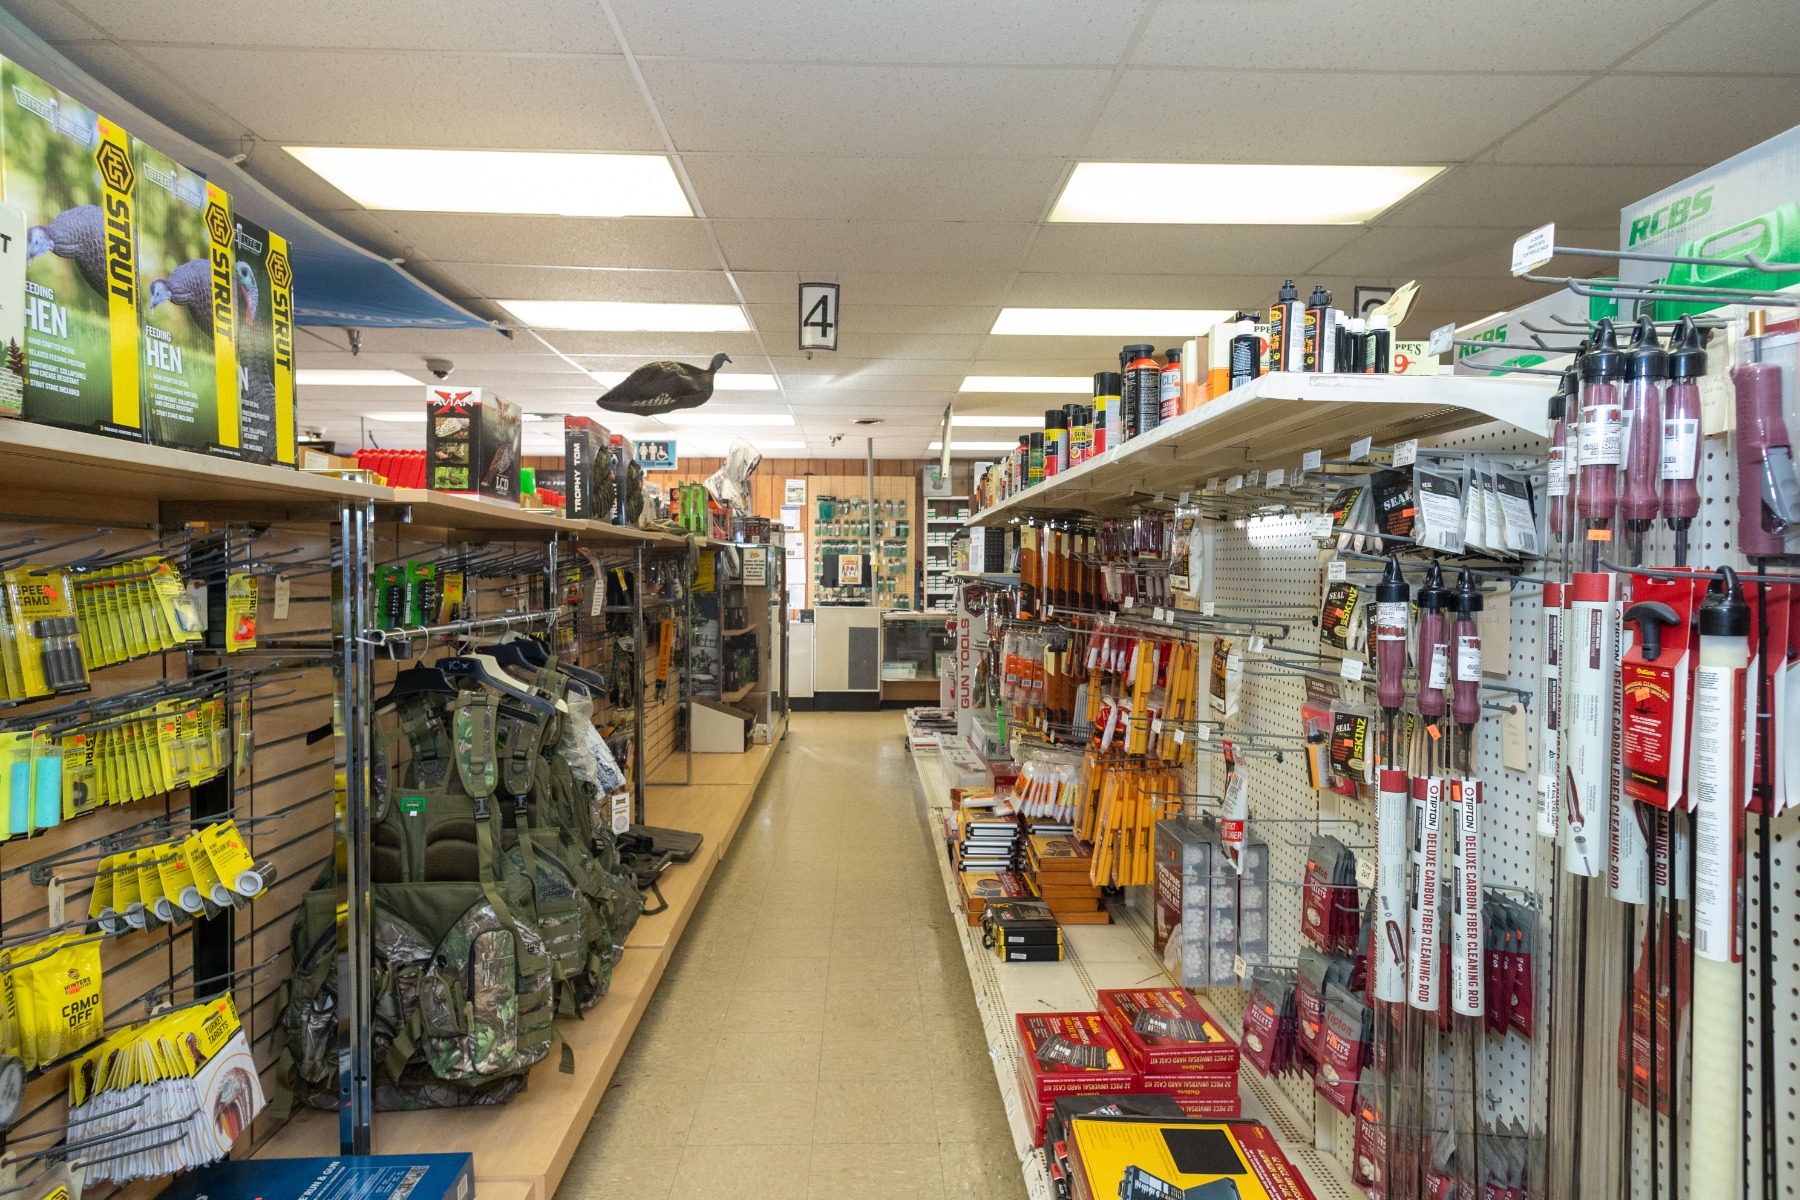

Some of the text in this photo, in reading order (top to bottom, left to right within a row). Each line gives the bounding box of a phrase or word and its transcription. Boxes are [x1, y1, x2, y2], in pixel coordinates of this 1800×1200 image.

[1628, 184, 1716, 247] RCBS
[106, 194, 133, 305] STRUT
[25, 281, 53, 299] EEDING
[212, 248, 234, 342] STRUT
[24, 296, 68, 339] HEN
[803, 294, 834, 338] 4
[145, 325, 171, 341] FEEDING
[273, 290, 291, 372] STRUT
[1458, 323, 1508, 360] RCBS
[145, 336, 183, 375] HEN
[1395, 343, 1422, 356] PPE'S
[433, 398, 474, 408] AVIAN
[496, 476, 509, 491] LCD
[573, 443, 582, 513] TROPHY TOM
[1383, 490, 1414, 511] SEAL
[1329, 591, 1345, 600] SEAL
[960, 618, 970, 709] GUN TOOLS
[1613, 670, 1621, 715] DELUXE
[1336, 723, 1351, 733] SEAL
[1355, 718, 1367, 753] SKINZ
[85, 739, 93, 767] STRU
[1612, 717, 1620, 765] CARBON
[1612, 769, 1620, 802] FIBER
[1611, 804, 1620, 863] CLEANING
[1611, 864, 1619, 889] ROD
[1655, 862, 1667, 887] ROD
[1418, 795, 1438, 1003] TIPTON DELUXE CARBON FIBER CLEANING ROD
[1465, 797, 1479, 1009] TIPTON DELUXE CARBON FIBER CLEANING ROD
[4, 975, 16, 1019] STRUT
[62, 993, 99, 1018] CAMO
[69, 1008, 93, 1028] OFF
[204, 1014, 224, 1036] TURKEY
[1250, 1009, 1273, 1028] PELLETS
[1327, 1009, 1354, 1036] Tipton
[207, 1021, 229, 1044] TARGETS
[1149, 1057, 1158, 1065] KIT
[1187, 1055, 1213, 1063] UNIVERSAL
[1043, 1084, 1051, 1092] KIT
[1051, 1084, 1066, 1092] CASE
[1066, 1083, 1082, 1091] HARD
[1081, 1083, 1109, 1091] UNIVERSAL
[1109, 1082, 1124, 1090] PIECE
[303, 1181, 322, 1196] RUN
[323, 1161, 341, 1176] GUN
